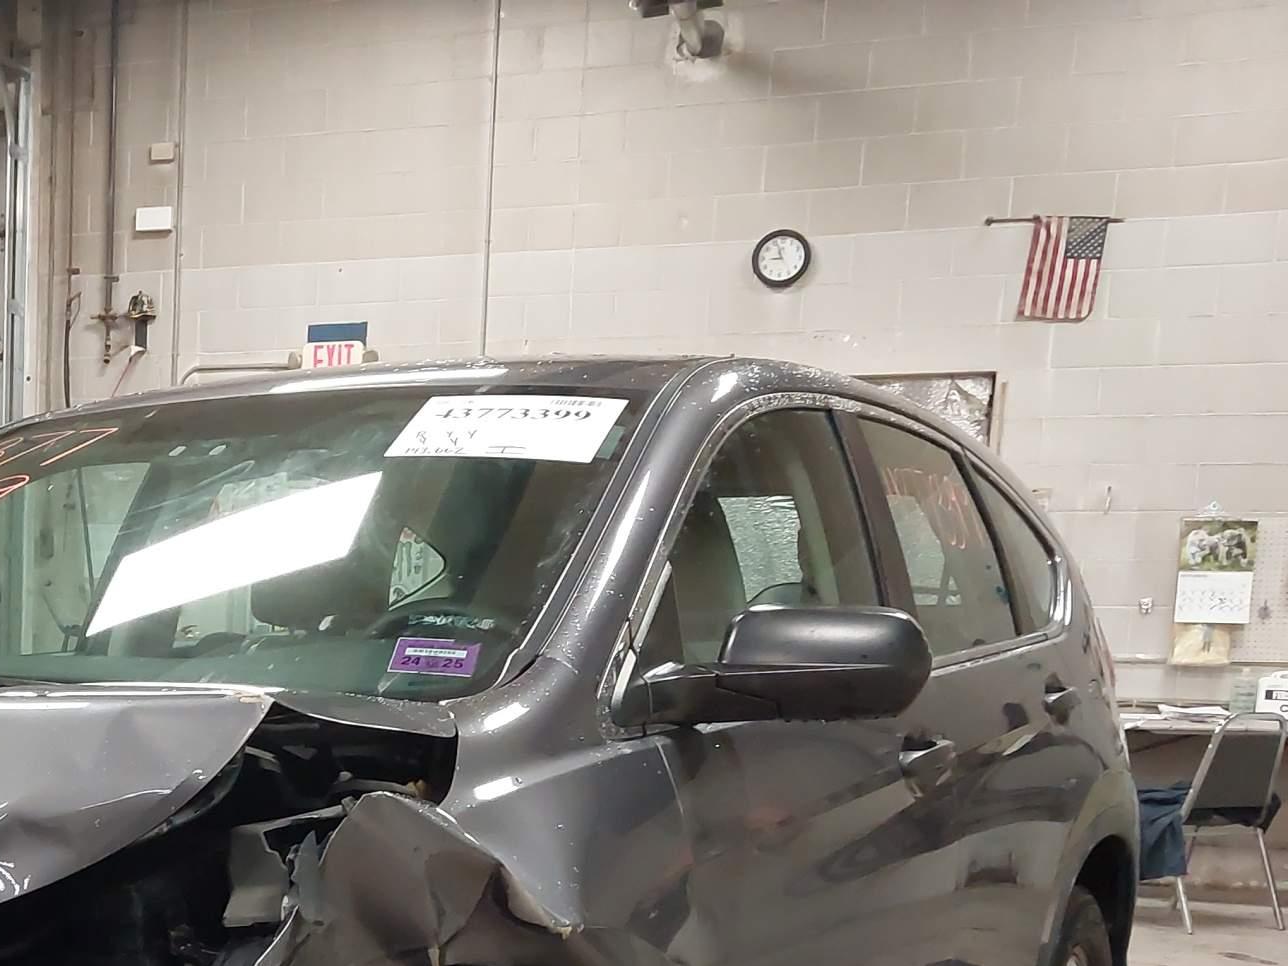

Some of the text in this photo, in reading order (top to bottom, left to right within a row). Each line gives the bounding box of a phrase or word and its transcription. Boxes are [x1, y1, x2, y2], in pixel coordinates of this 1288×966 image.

[313, 343, 355, 368] EXIT
[435, 407, 592, 421] 43773399
[400, 656, 421, 666] 24
[441, 658, 464, 669] 25
